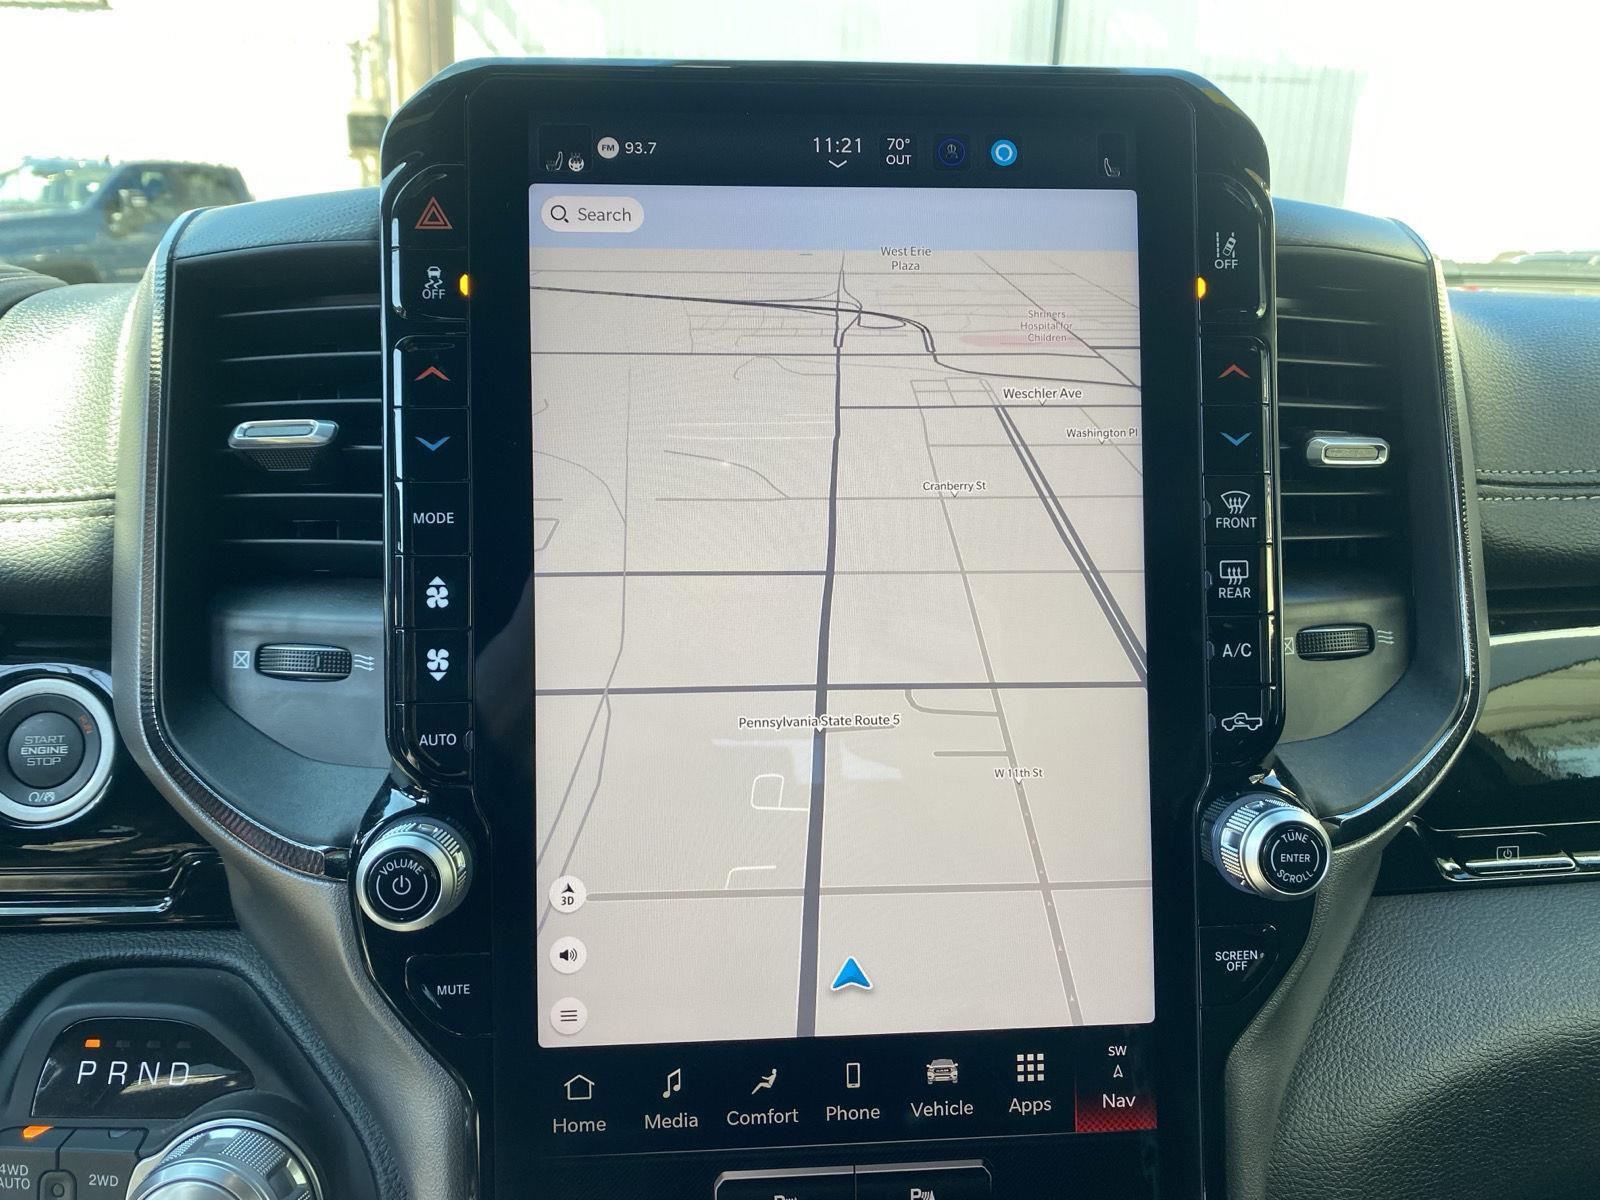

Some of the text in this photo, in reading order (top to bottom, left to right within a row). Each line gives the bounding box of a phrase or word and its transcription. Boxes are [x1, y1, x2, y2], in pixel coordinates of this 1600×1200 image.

[601, 143, 615, 152] FM
[624, 141, 657, 156] 93.7
[813, 137, 862, 153] 11:21
[886, 138, 911, 150] 70°
[886, 154, 912, 165] OUT
[577, 207, 632, 224] Search
[880, 245, 932, 257] West Erie
[891, 260, 920, 272] Plaza
[1214, 259, 1239, 270] OFF
[422, 288, 446, 300] OFF
[1028, 309, 1066, 319] Shriners
[1020, 321, 1073, 333] Hospital for
[1027, 333, 1067, 343] Children
[1003, 387, 1082, 400] Weschler Ave
[1066, 427, 1138, 440] Washington Pl
[922, 480, 987, 493] Cranberry St
[413, 512, 455, 525] MODE
[1215, 517, 1257, 530] FRONT
[1218, 587, 1251, 600] REAR
[1222, 644, 1252, 658] A/C
[739, 714, 900, 730] Pennsylvania State Route 5
[24, 735, 65, 745] START
[419, 733, 457, 746] AUTO
[20, 746, 69, 755] ENGINE
[26, 758, 61, 767] STOP
[994, 767, 1043, 779] W 11th St
[1281, 831, 1309, 844] TUNE
[1280, 854, 1311, 862] ENTER
[379, 858, 425, 877] VOLUME
[1276, 869, 1314, 883] SCROLL
[560, 895, 574, 906] 3D
[1215, 950, 1258, 961] SCREEN
[1226, 961, 1248, 972] OFF
[436, 983, 471, 996] MUTE
[1108, 1045, 1127, 1056] SW
[1009, 1097, 1052, 1115] Apps
[1102, 1092, 1136, 1110] Nav
[826, 1104, 881, 1121] Phone
[910, 1100, 974, 1118] Vehicle
[644, 1113, 699, 1131] Media
[726, 1109, 799, 1127] Comfort
[553, 1117, 607, 1134] Home
[0, 1164, 29, 1176] 4WD
[89, 1174, 119, 1187] 2WD
